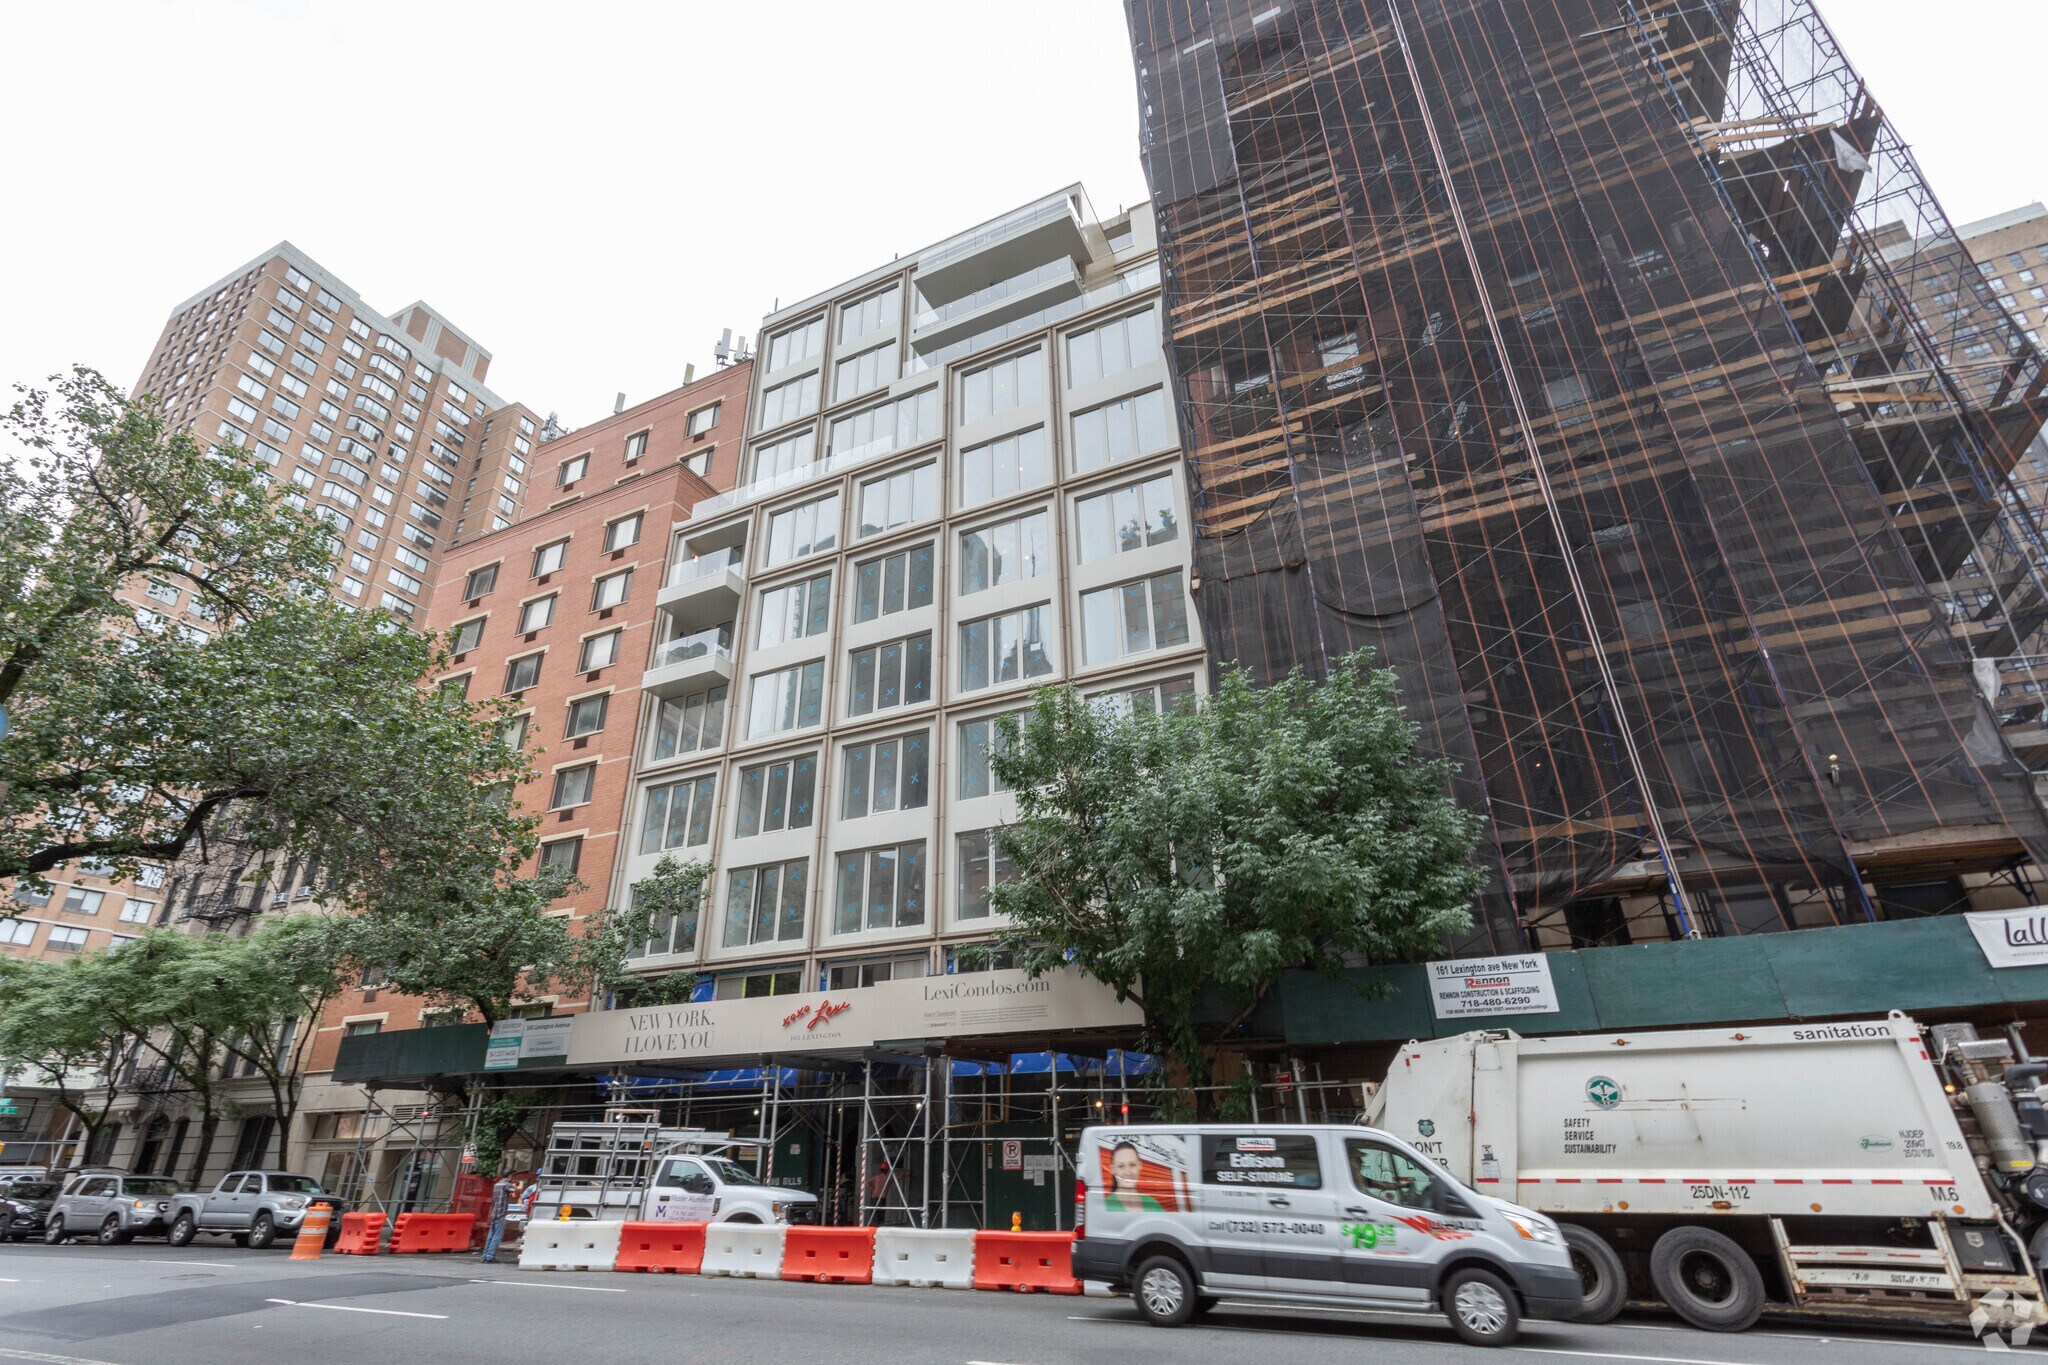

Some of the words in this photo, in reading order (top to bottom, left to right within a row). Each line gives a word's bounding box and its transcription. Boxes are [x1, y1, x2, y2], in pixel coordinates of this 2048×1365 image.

[1436, 966, 1449, 976] 161
[1450, 963, 1486, 976] Lexington
[1488, 963, 1500, 972] ave
[1501, 960, 1519, 971] New
[1519, 958, 1538, 969] York
[924, 979, 1050, 1001] LexiCondos.com
[1439, 992, 1460, 1000] RENNON
[1460, 989, 1499, 998] CONSTRUCTION
[1504, 986, 1540, 995] SCAFFOLDING
[1461, 996, 1531, 1008] 718-480-6290
[627, 1013, 665, 1032] NEW
[782, 1005, 811, 1027] xoxo
[534, 1023, 554, 1031] Lexington
[1793, 1024, 1890, 1041] sanitation
[624, 1037, 631, 1054] I
[634, 1034, 678, 1053] LOVE
[681, 1031, 716, 1050] YOU
[802, 1031, 842, 1041] LEXINGTON
[1564, 1118, 1591, 1128] SAFETY
[1564, 1130, 1594, 1141] SERVICE
[1564, 1144, 1617, 1154] SUSTAINABILITY
[1945, 1141, 1963, 1151] 19.8
[1229, 1153, 1286, 1168] Edison
[782, 1177, 802, 1186] BILLS
[1690, 1185, 1750, 1200] 25DN-112
[1929, 1186, 1960, 1202] M.6
[1208, 1221, 1225, 1231] Call
[1226, 1220, 1259, 1234] (732)
[1261, 1221, 1326, 1235] 572-0040
